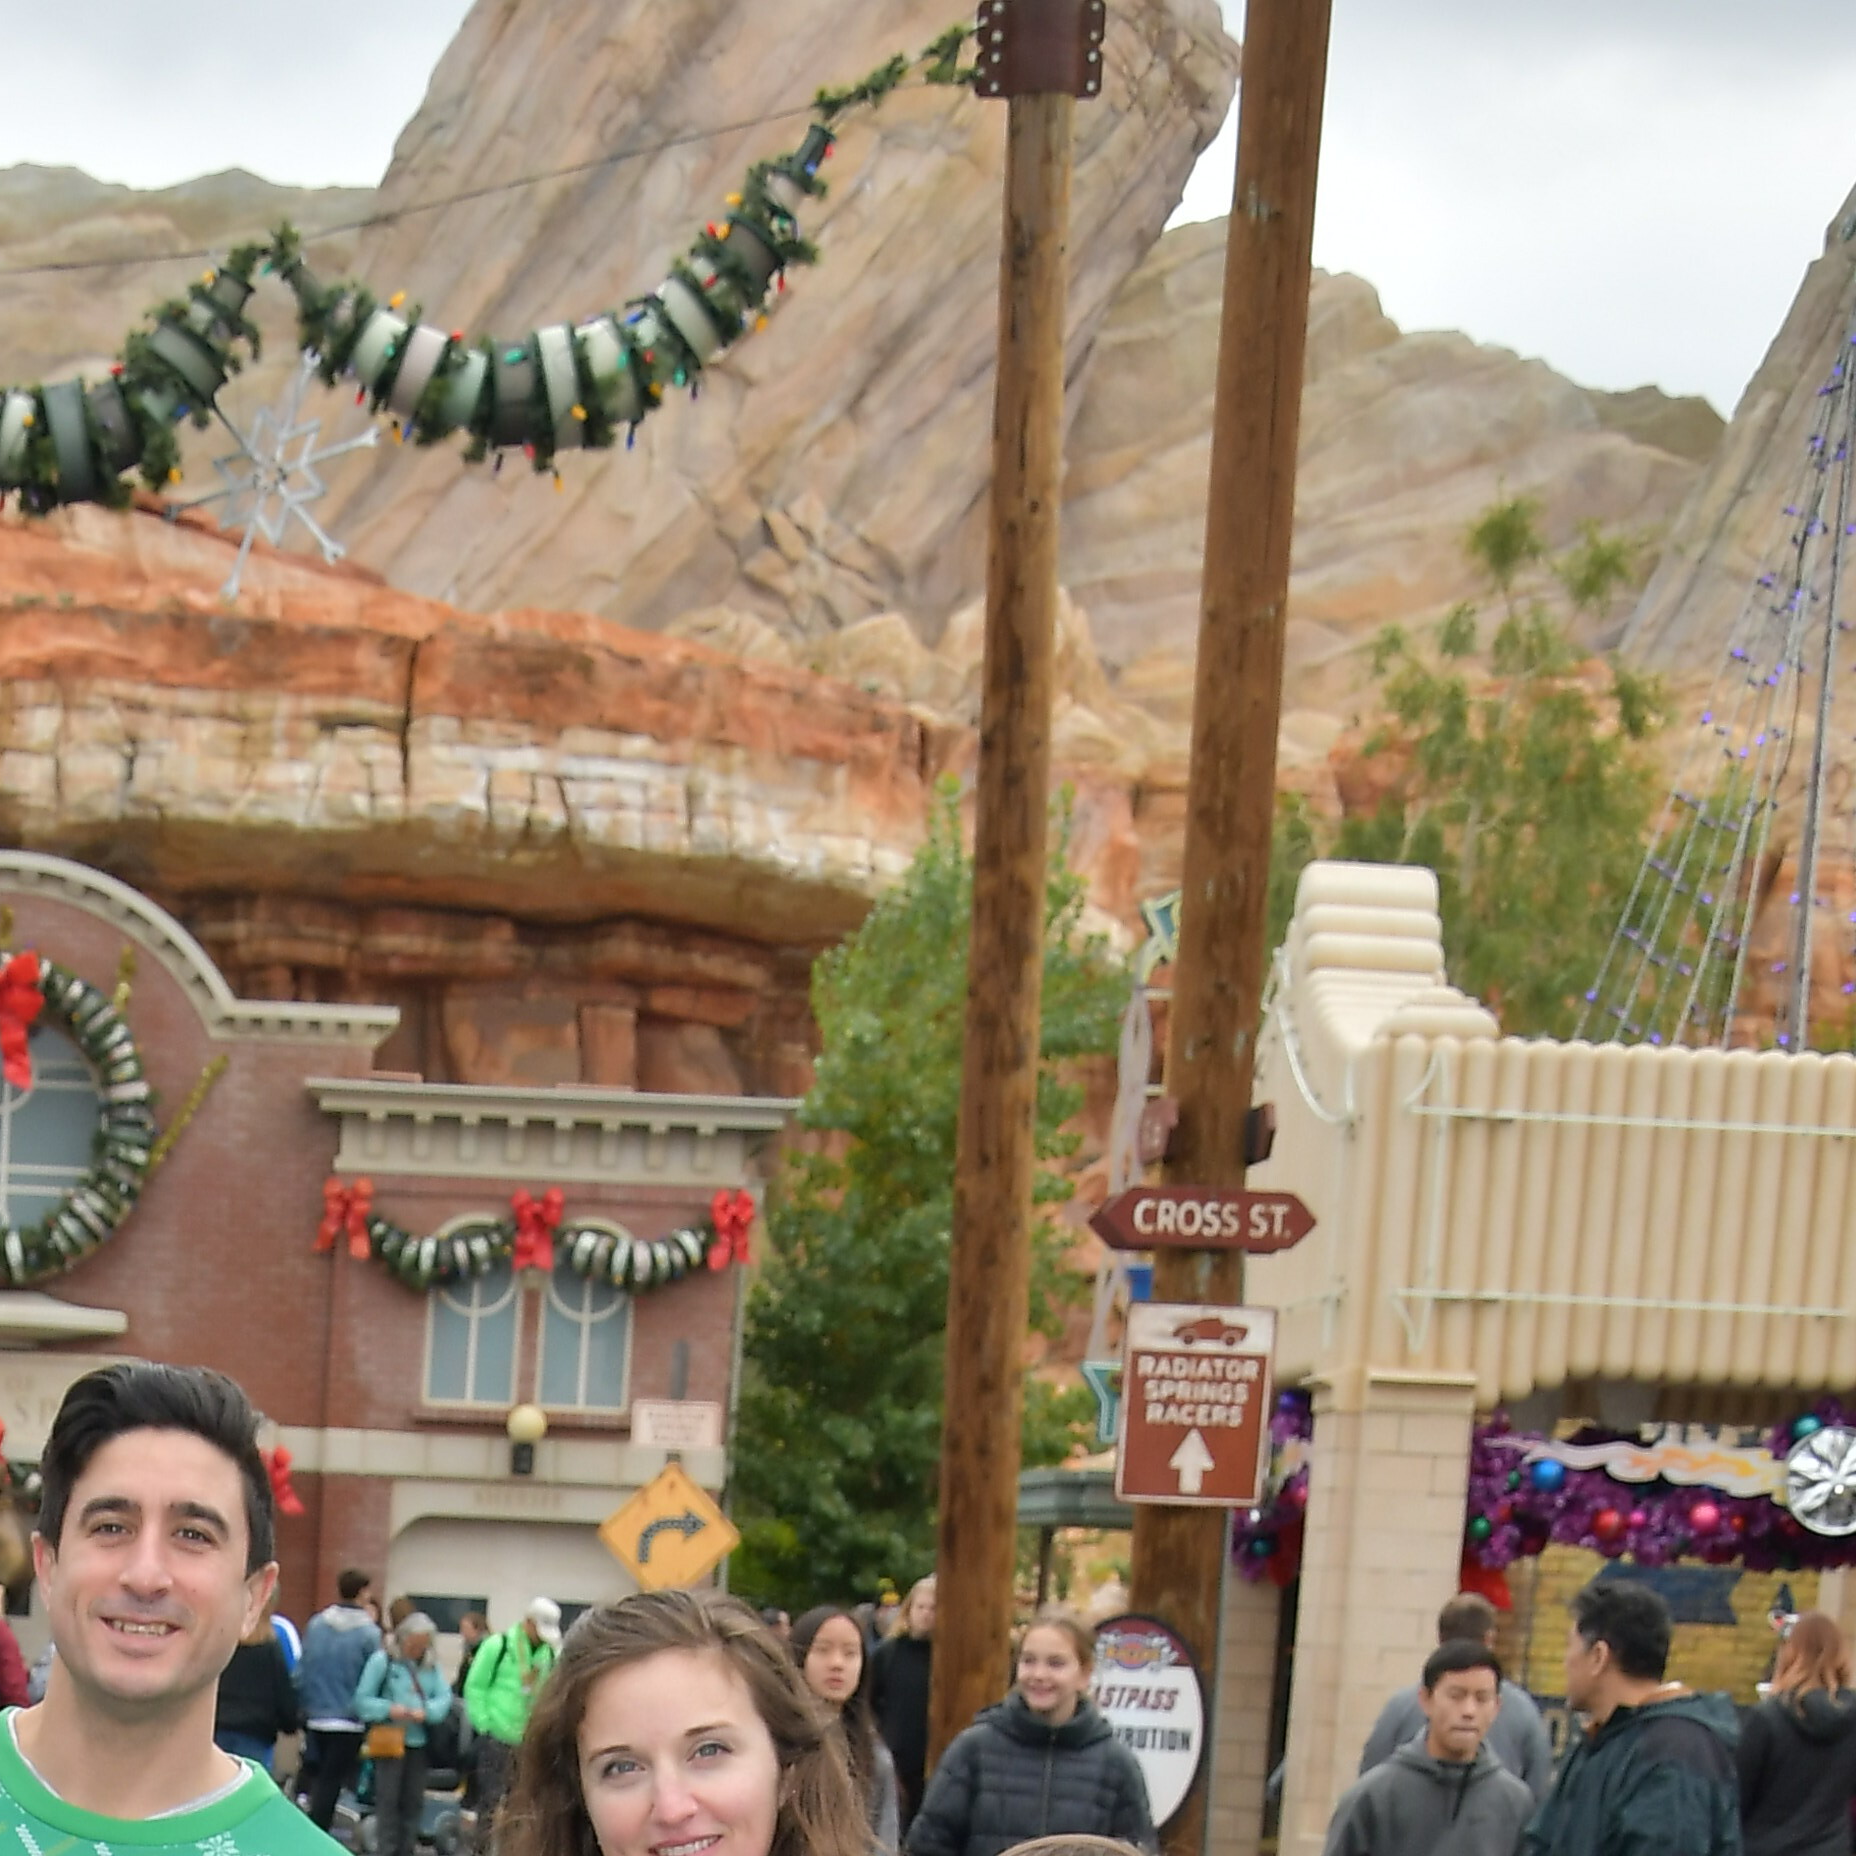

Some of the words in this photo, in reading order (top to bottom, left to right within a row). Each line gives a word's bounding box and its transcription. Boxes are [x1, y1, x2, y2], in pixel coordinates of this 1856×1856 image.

[1132, 1197, 1240, 1238] CROSS
[1248, 1202, 1292, 1240] ST.
[1137, 1354, 1260, 1382] RADIATOR
[1144, 1378, 1250, 1406] SPRINGS
[1145, 1402, 1243, 1428] RACERS
